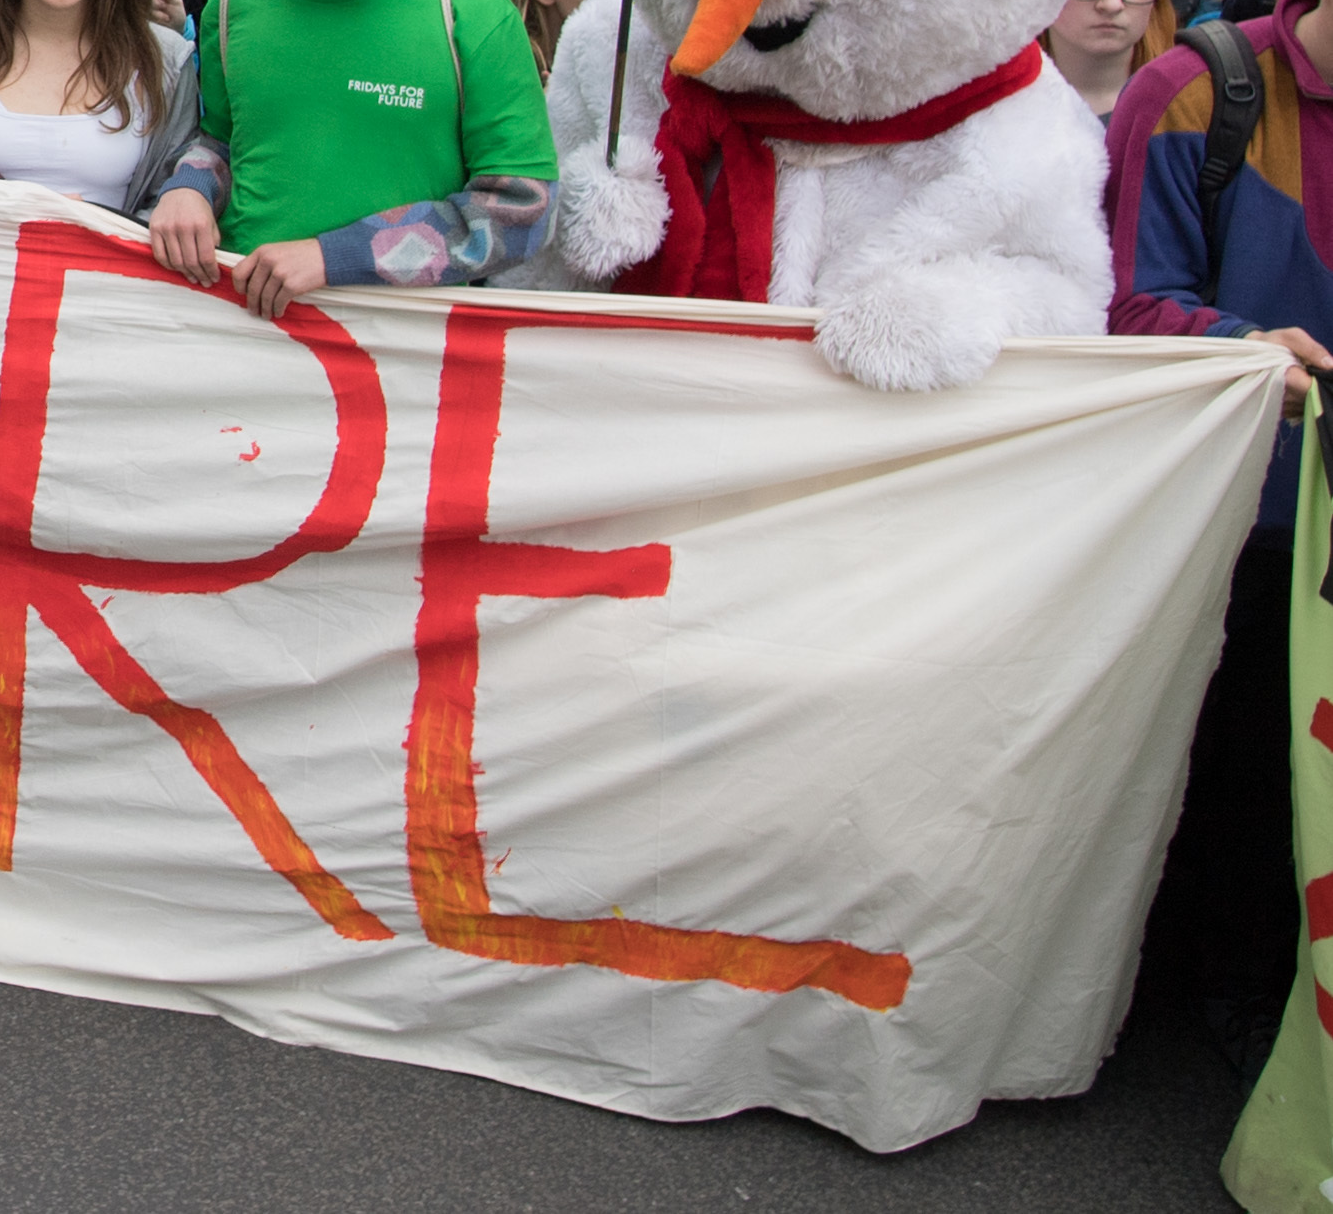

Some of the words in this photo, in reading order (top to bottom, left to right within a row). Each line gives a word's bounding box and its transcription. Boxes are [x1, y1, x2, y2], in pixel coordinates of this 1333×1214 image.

[347, 79, 396, 96] FRIDAYS
[399, 85, 425, 98] FOR
[377, 94, 424, 109] FUTURE
